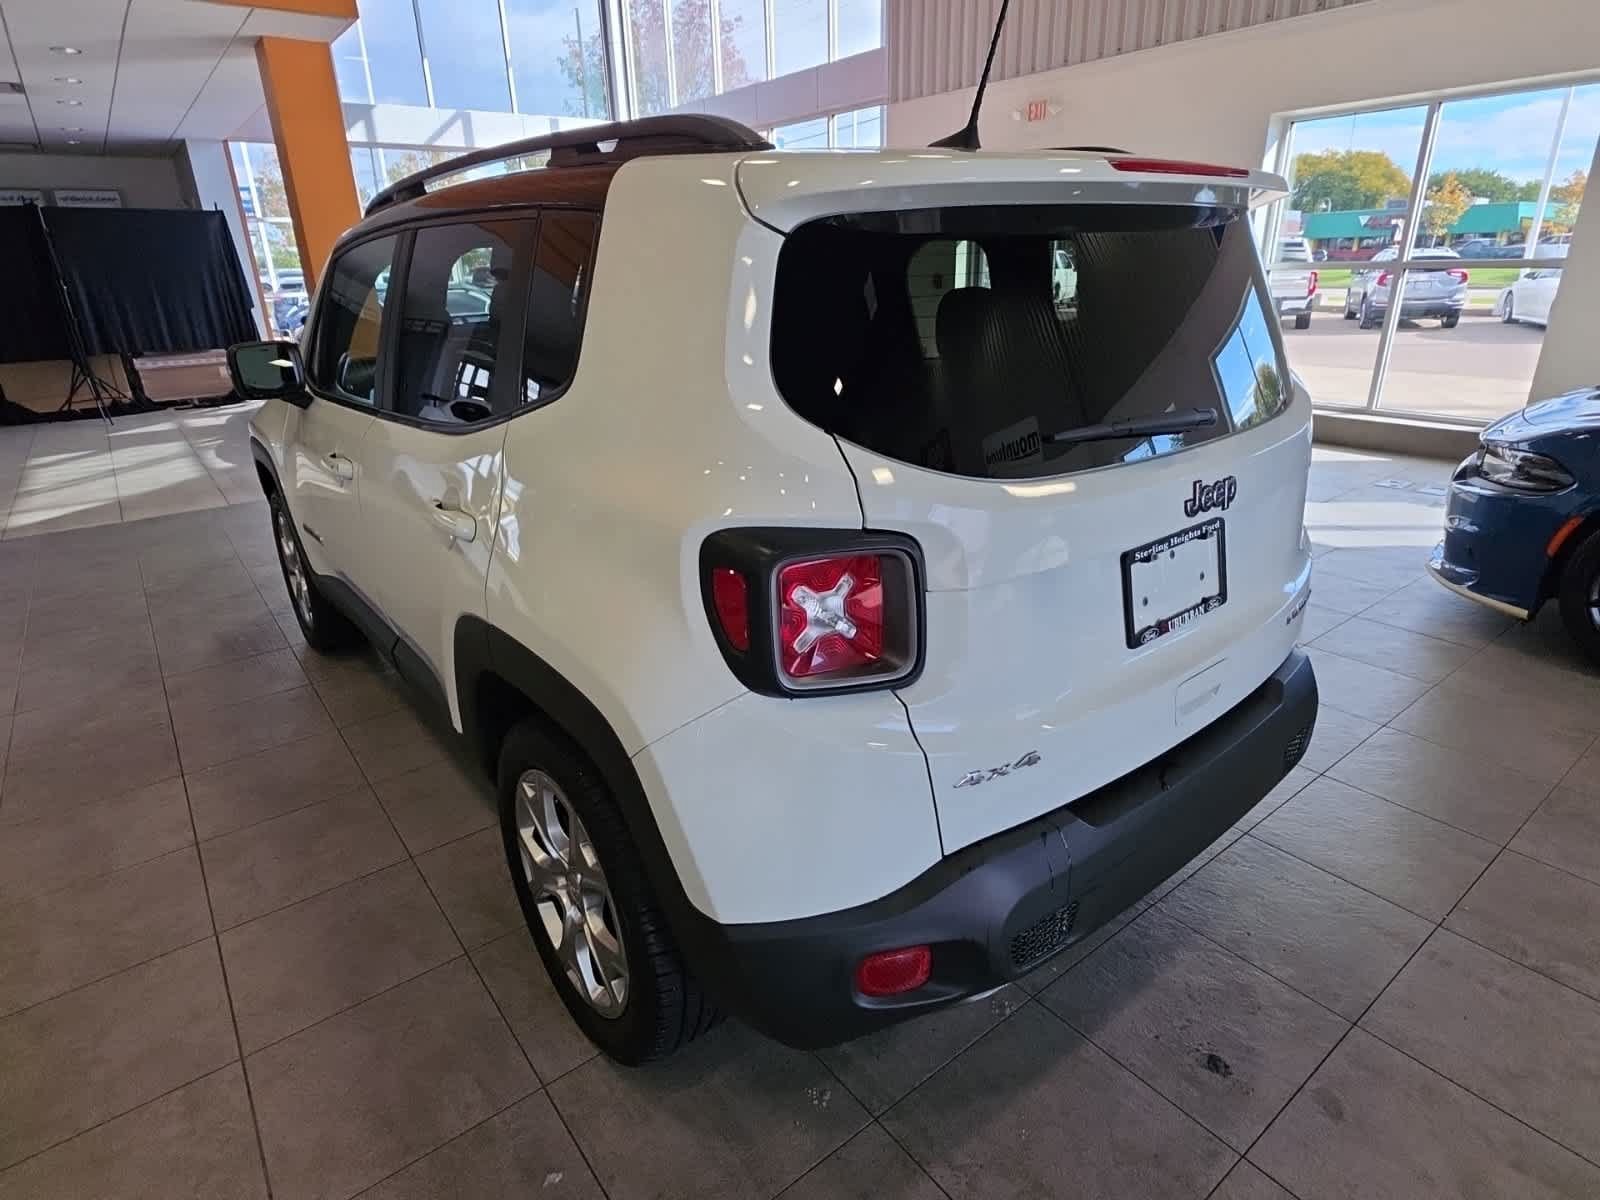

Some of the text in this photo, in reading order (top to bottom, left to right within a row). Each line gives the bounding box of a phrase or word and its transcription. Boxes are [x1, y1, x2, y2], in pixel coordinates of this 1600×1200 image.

[1027, 101, 1048, 121] EXIT
[1184, 475, 1237, 518] Jeep
[1134, 520, 1220, 560] Sterling Heights Ford
[1160, 603, 1205, 632] UBURBAN
